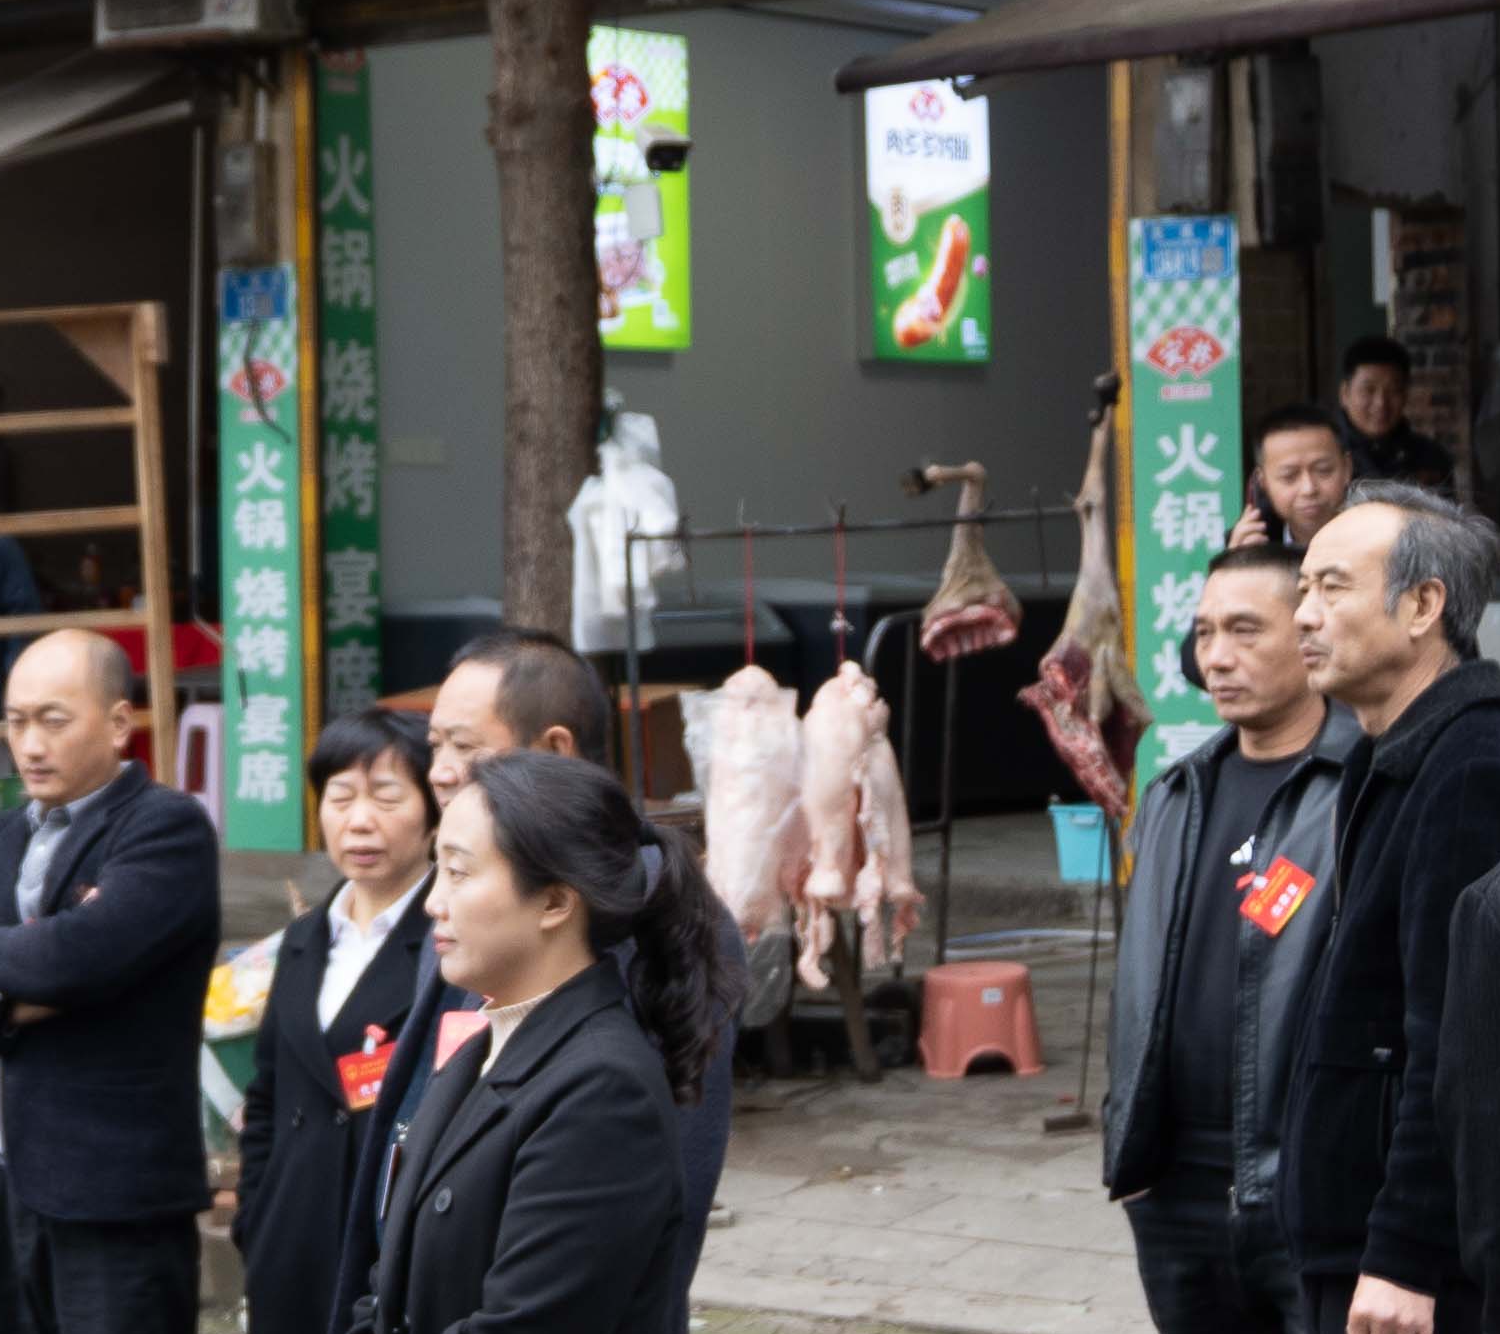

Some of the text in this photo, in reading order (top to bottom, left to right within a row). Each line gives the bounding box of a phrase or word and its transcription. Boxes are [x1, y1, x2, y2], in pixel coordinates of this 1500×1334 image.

[320, 134, 375, 310] 火锅
[321, 338, 378, 519] 烧烤
[1152, 423, 1226, 553] 火锅
[233, 441, 288, 550] 火锅
[233, 566, 289, 680] 烧烤
[235, 692, 289, 805] 宴席
